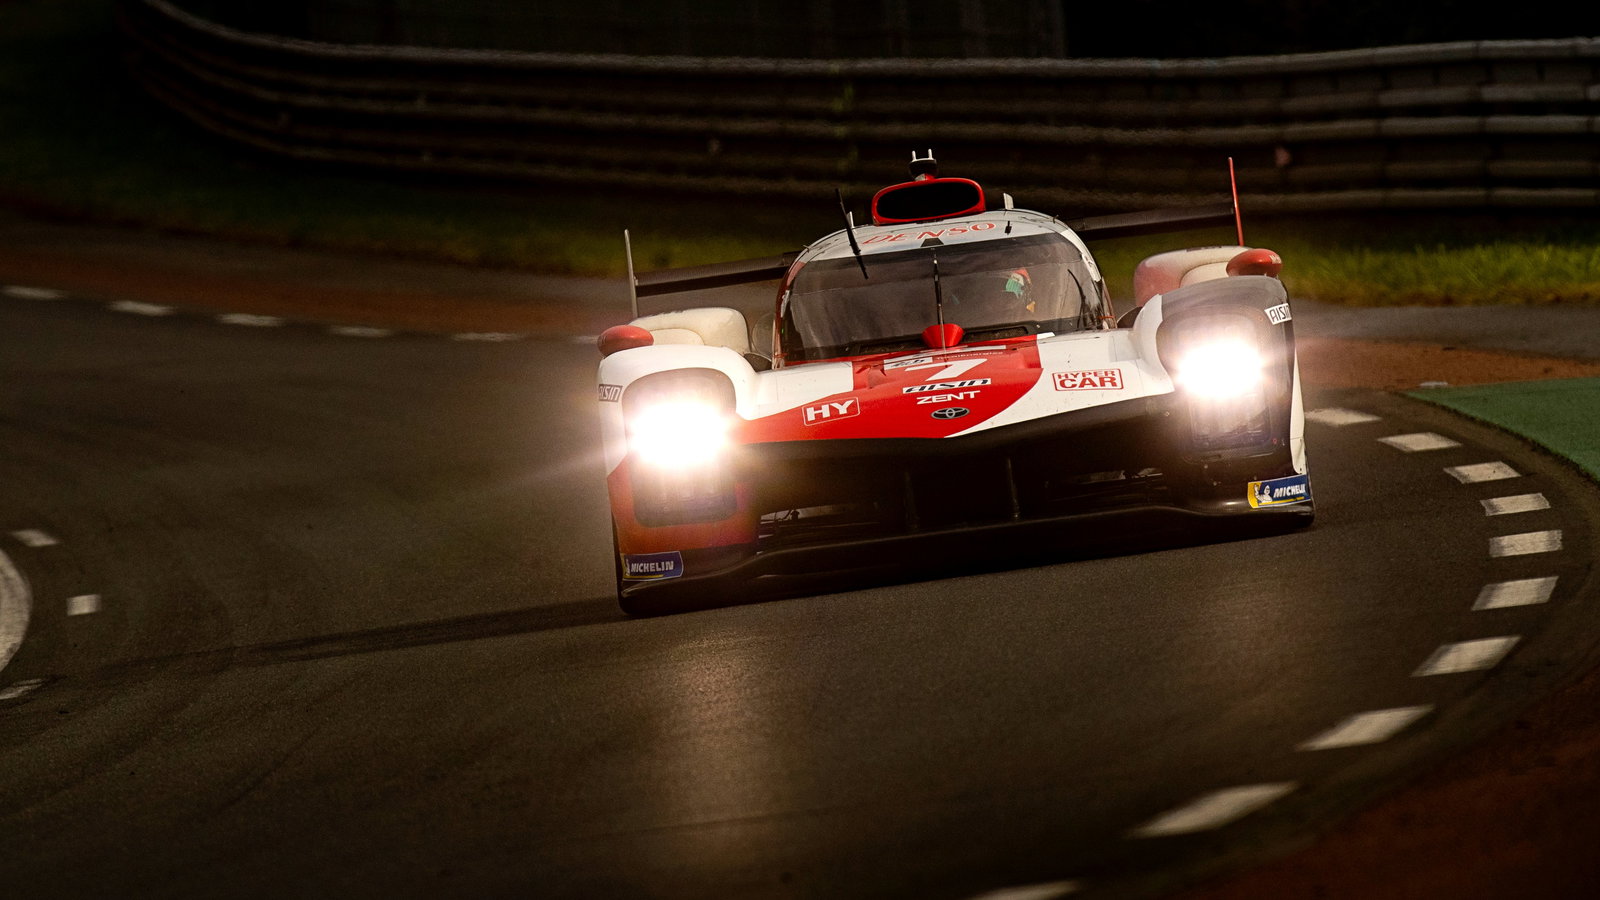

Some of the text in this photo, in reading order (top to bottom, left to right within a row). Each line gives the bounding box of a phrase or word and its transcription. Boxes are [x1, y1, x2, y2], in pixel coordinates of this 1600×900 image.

[862, 223, 996, 245] DENSO
[904, 358, 988, 382] 7
[1057, 370, 1116, 379] HYPER
[1059, 376, 1118, 389] CAR
[916, 390, 981, 405] ZENT
[806, 399, 855, 422] HY
[631, 560, 674, 573] MICHELIN
